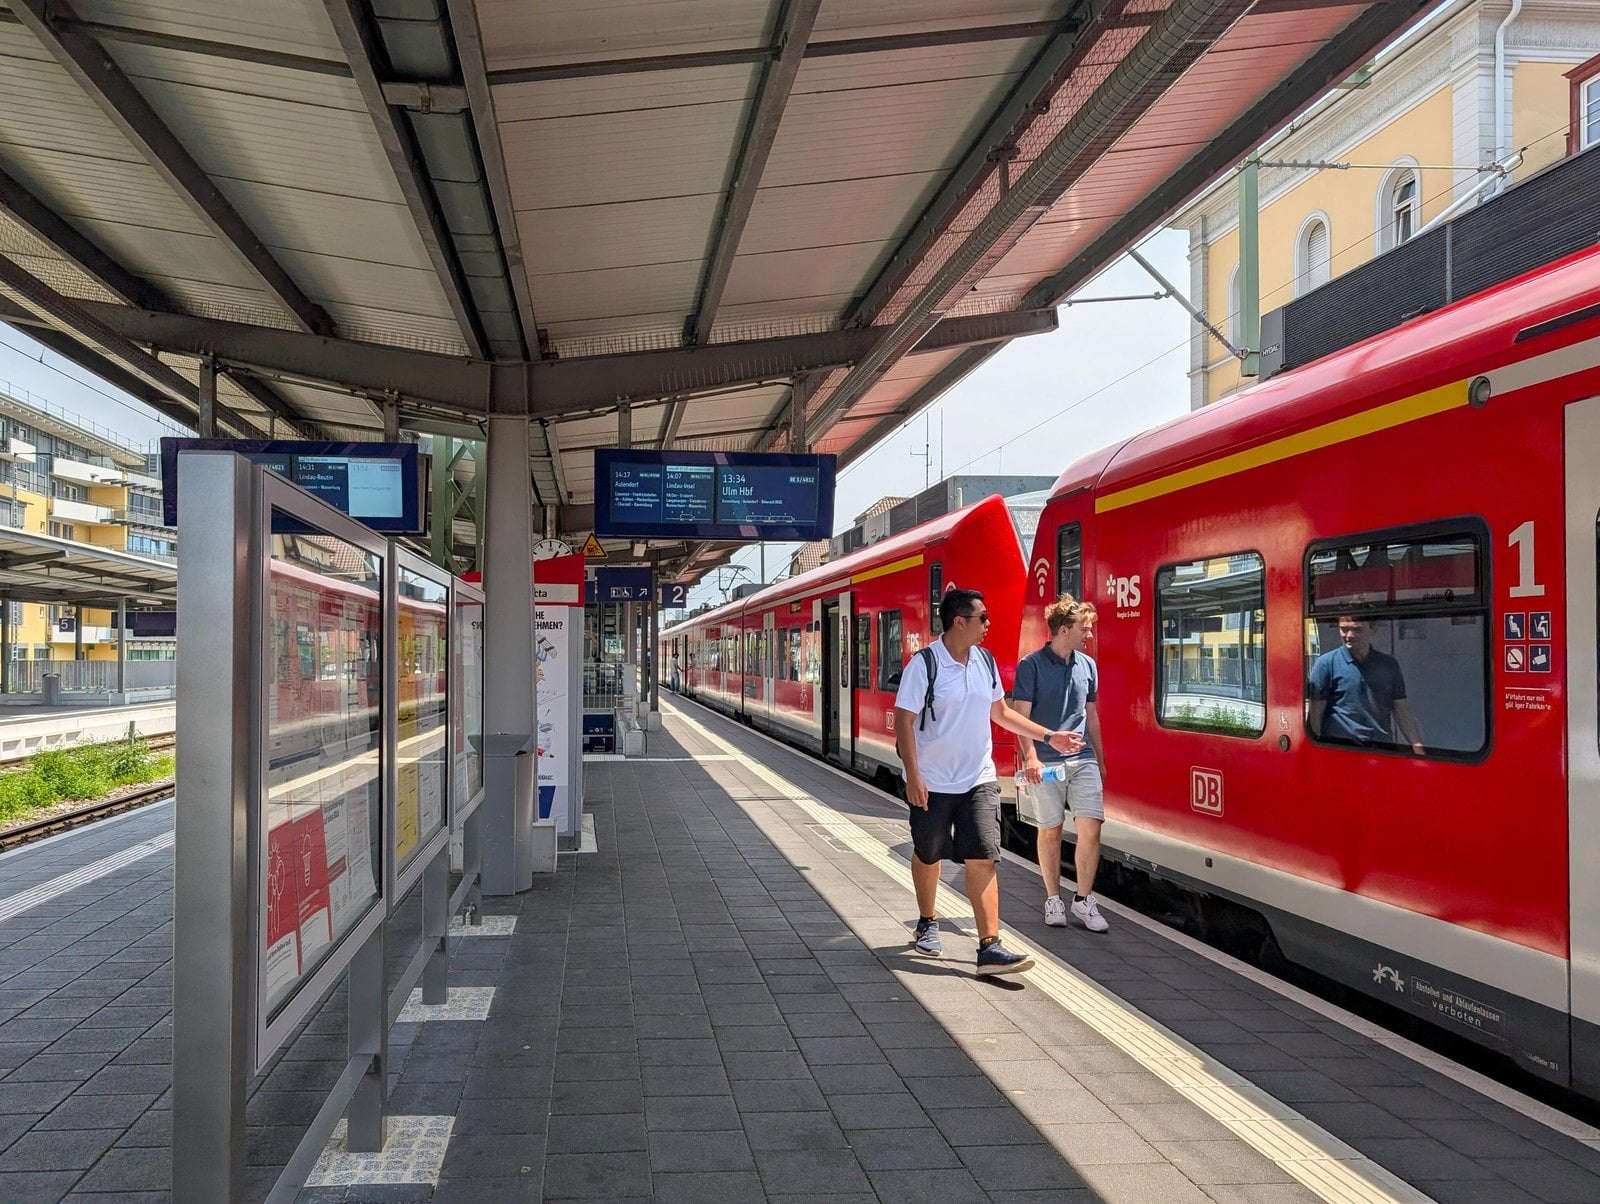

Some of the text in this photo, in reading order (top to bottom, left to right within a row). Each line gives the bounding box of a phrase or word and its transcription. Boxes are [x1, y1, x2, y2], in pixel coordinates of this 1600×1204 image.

[722, 474, 746, 484] 13:34
[722, 486, 753, 496] Ulm Hbf
[1508, 520, 1545, 598] 1
[672, 585, 684, 603] 2
[1117, 575, 1140, 607] RS
[61, 619, 69, 630] 5
[1194, 774, 1220, 808] DB
[1432, 1000, 1481, 1026] verboten
[1443, 993, 1453, 1003] und
[1455, 996, 1500, 1022] Ablaufenlassen
